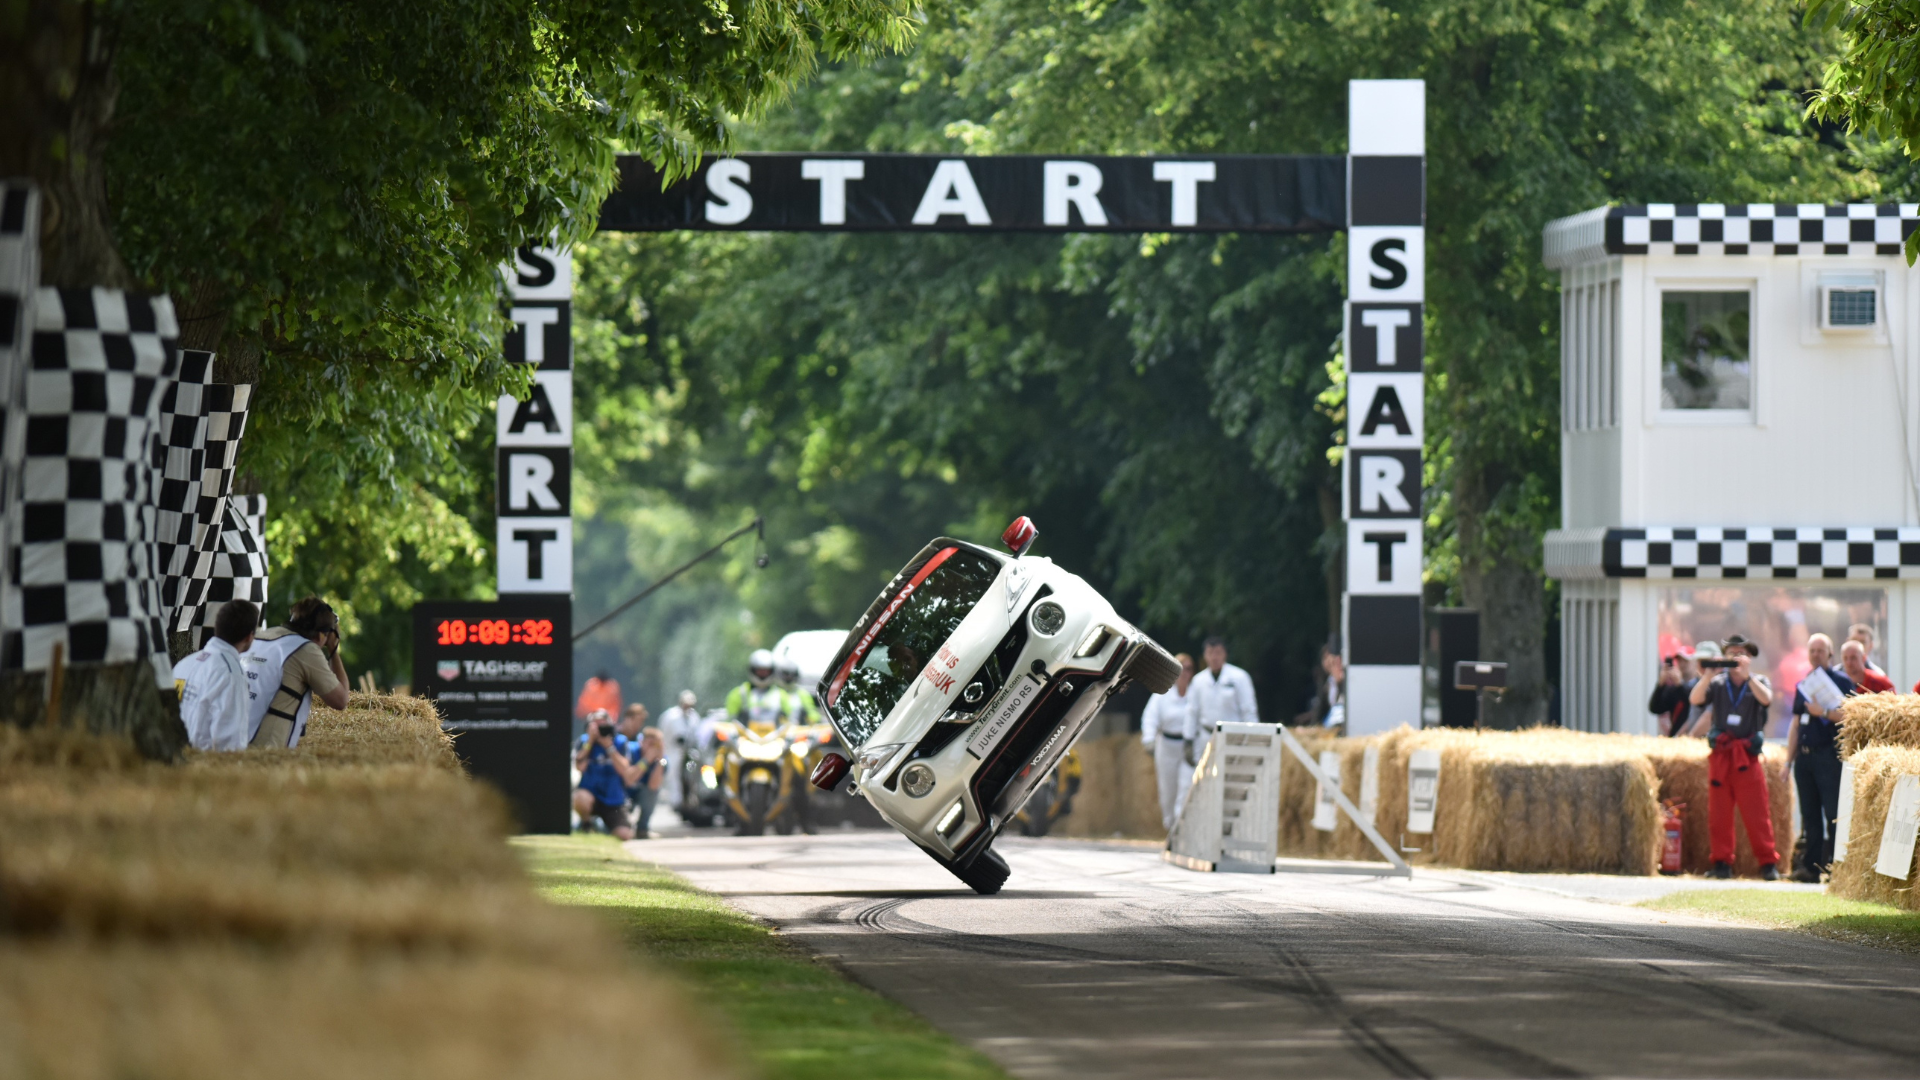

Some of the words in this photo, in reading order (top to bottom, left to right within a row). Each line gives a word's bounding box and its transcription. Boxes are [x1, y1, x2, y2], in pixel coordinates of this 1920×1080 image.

[705, 158, 1216, 226] START
[507, 236, 561, 579] START
[1359, 238, 1413, 582] START
[438, 620, 553, 645] 10:09:32
[855, 583, 914, 656] NISSAN
[978, 725, 999, 750] JUKE
[996, 698, 1021, 728] NISMO
[1020, 684, 1032, 699] RS
[1030, 724, 1067, 766] YOKOHAMA
